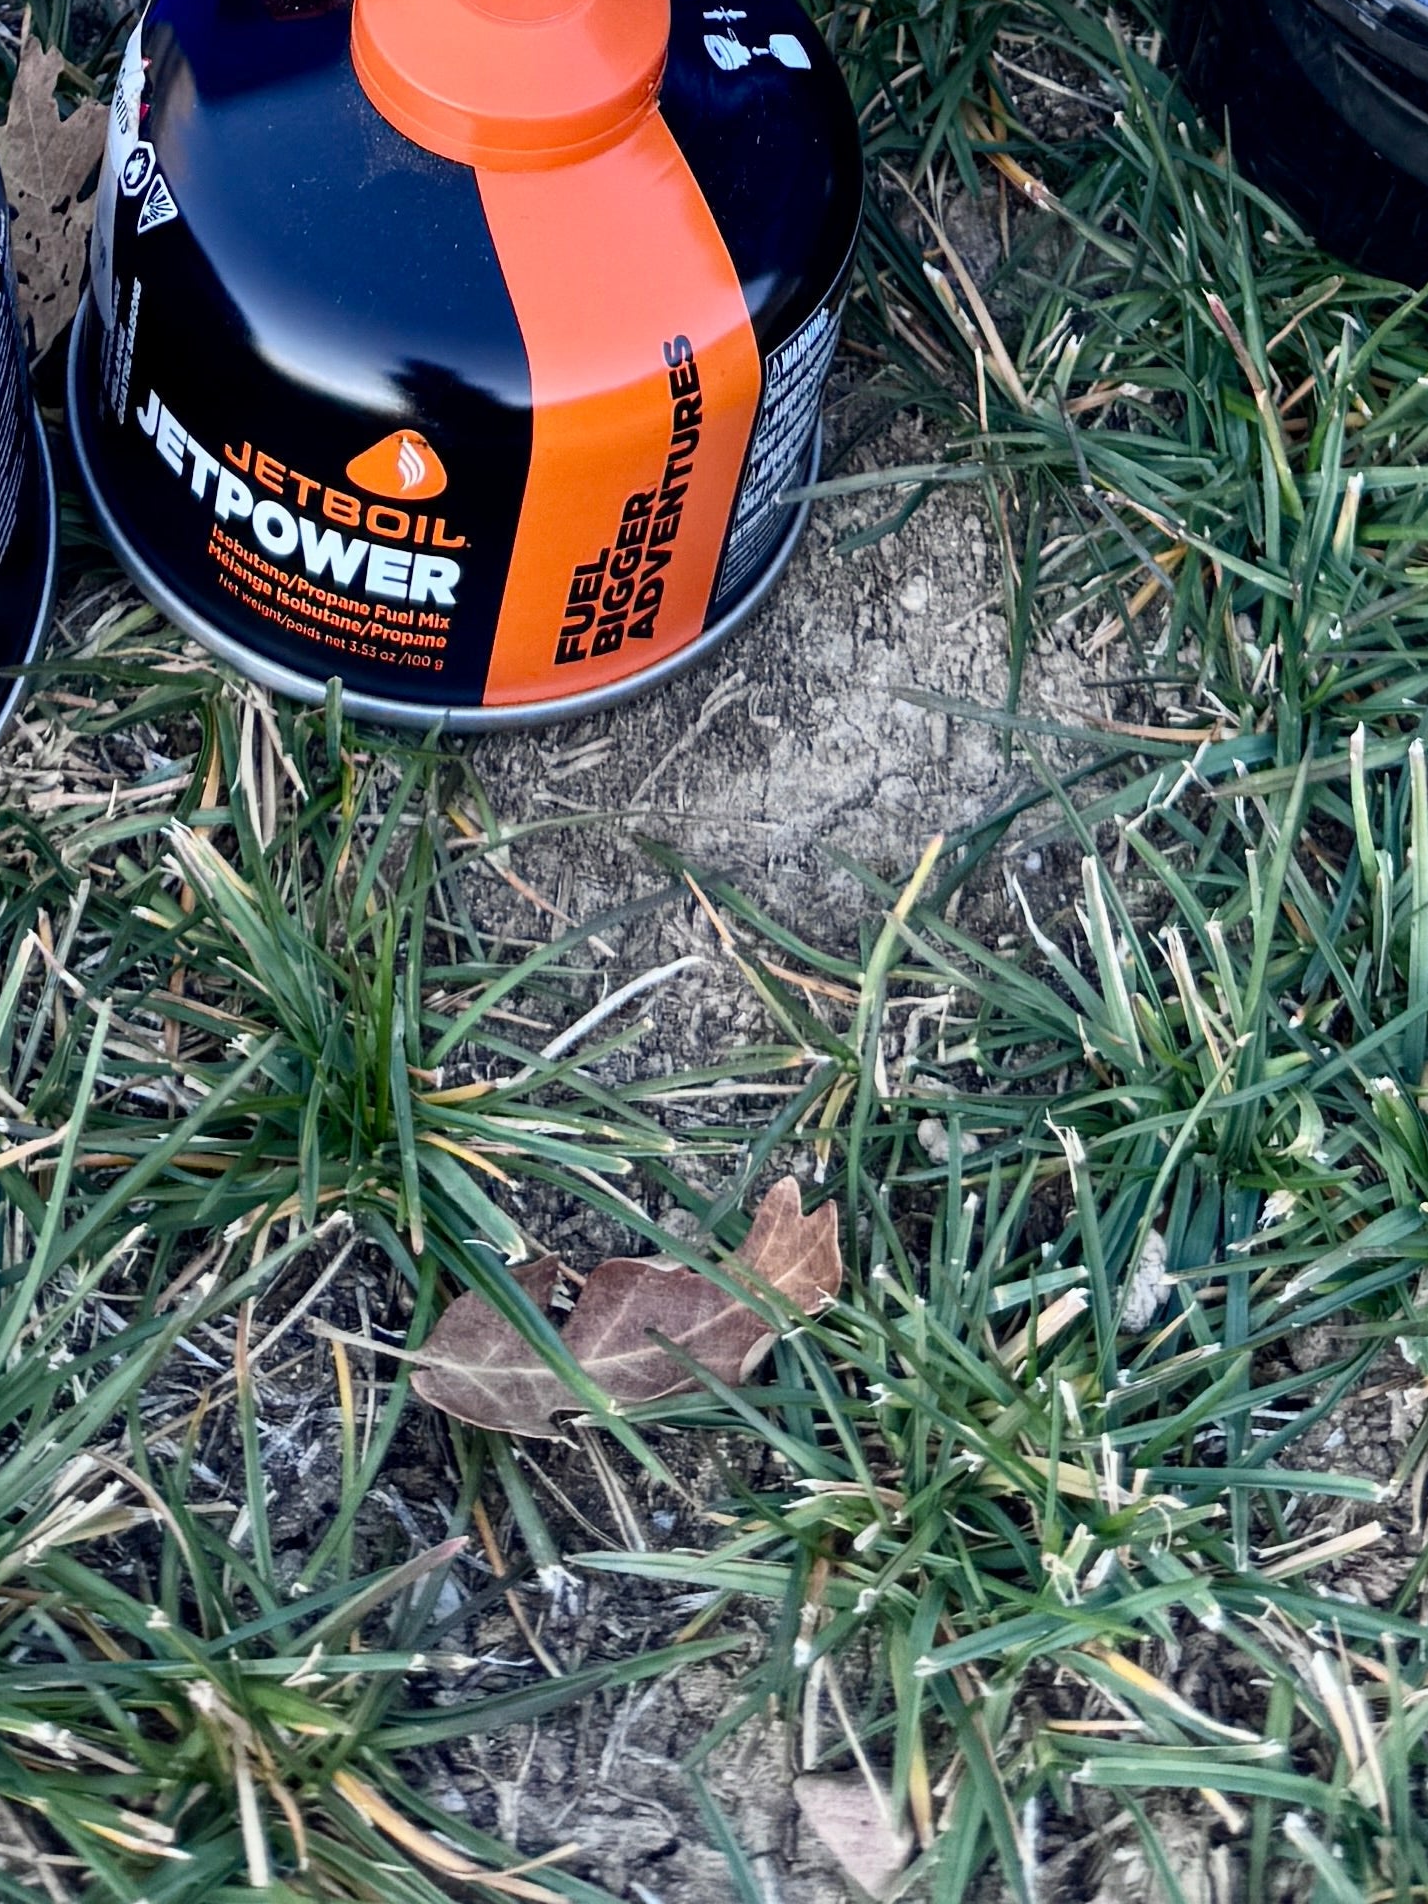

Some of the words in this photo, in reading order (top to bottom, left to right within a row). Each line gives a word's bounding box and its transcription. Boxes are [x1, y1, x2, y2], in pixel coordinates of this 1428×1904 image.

[136, 389, 461, 605] JETPOWER
[627, 334, 703, 640] ADVENTURES
[213, 523, 370, 617] Isobutane/Propane
[375, 604, 415, 626] Fuel
[418, 613, 451, 630] Mix
[242, 590, 322, 640] weight/poids
[325, 630, 347, 651] net
[349, 637, 378, 657] 3.53
[379, 650, 396, 663] oz
[276, 587, 448, 650] Isobutane/Propane
[554, 547, 611, 665] FUEL
[590, 488, 657, 658] BIGGER
